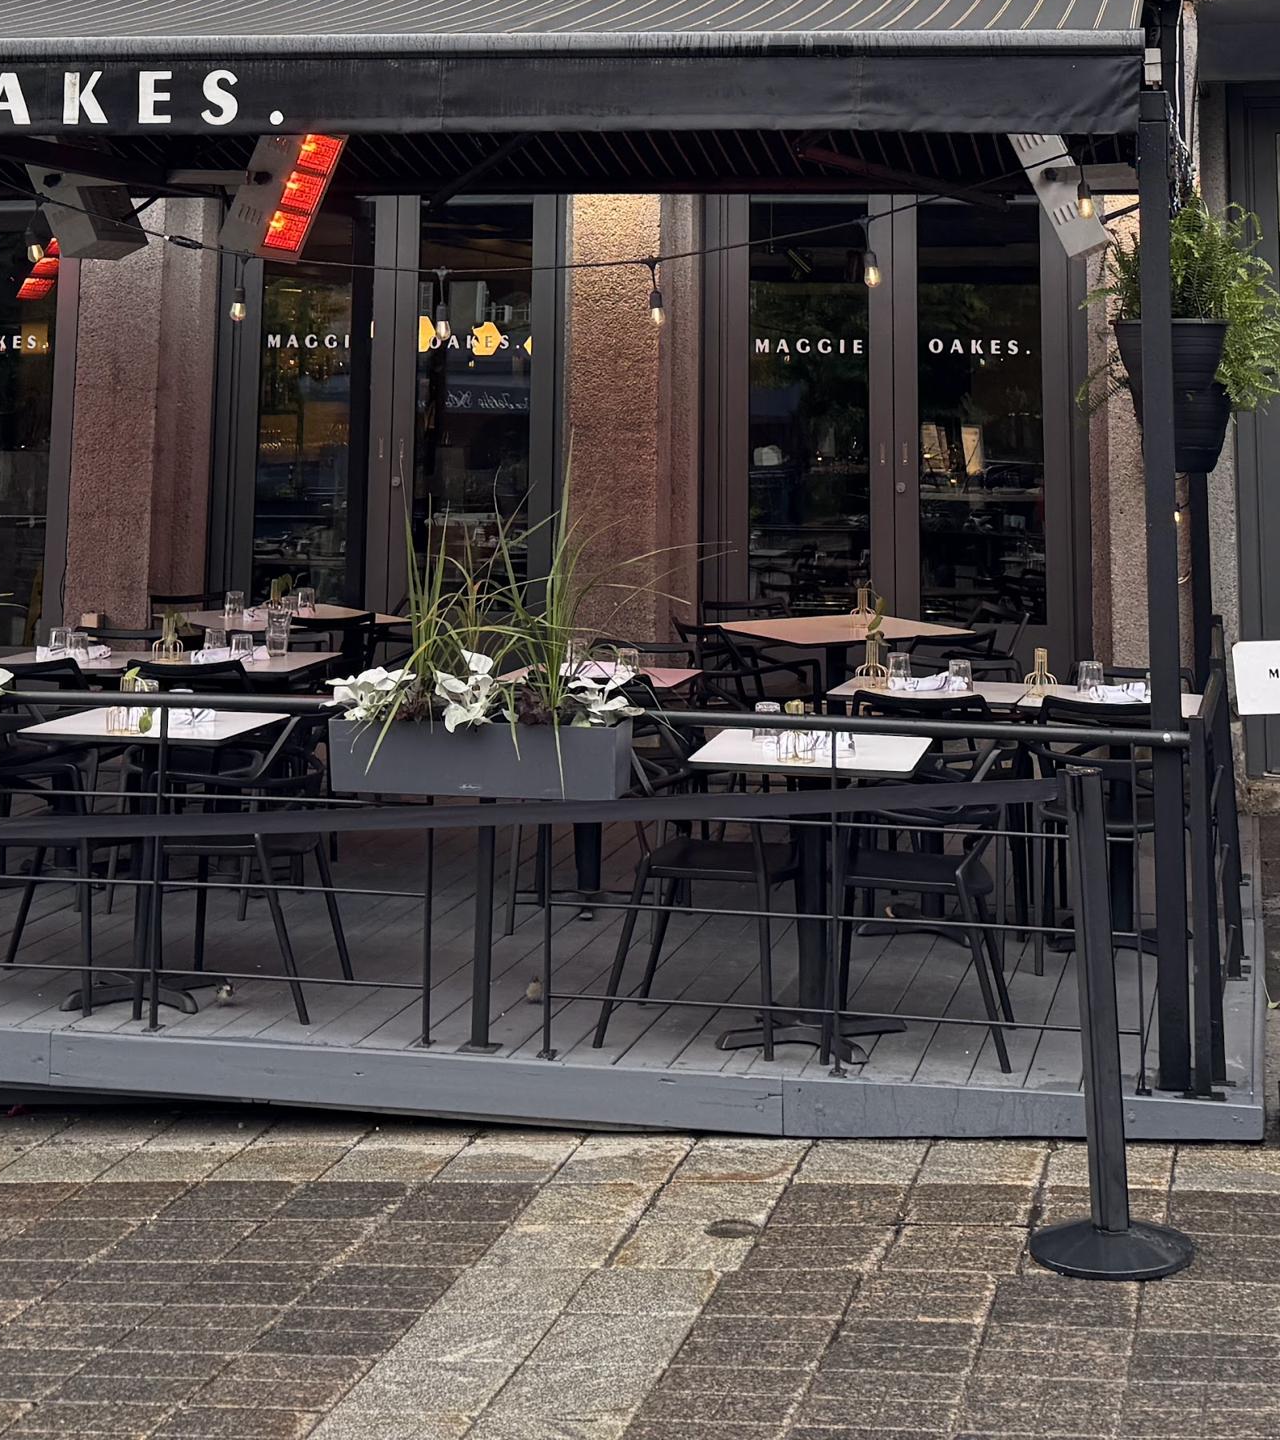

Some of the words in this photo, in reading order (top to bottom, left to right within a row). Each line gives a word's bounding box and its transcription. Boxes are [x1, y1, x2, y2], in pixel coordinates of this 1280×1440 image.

[267, 334, 350, 349] MAGGI
[755, 338, 863, 354] MAGGIE
[928, 338, 1031, 355] OAKES.
